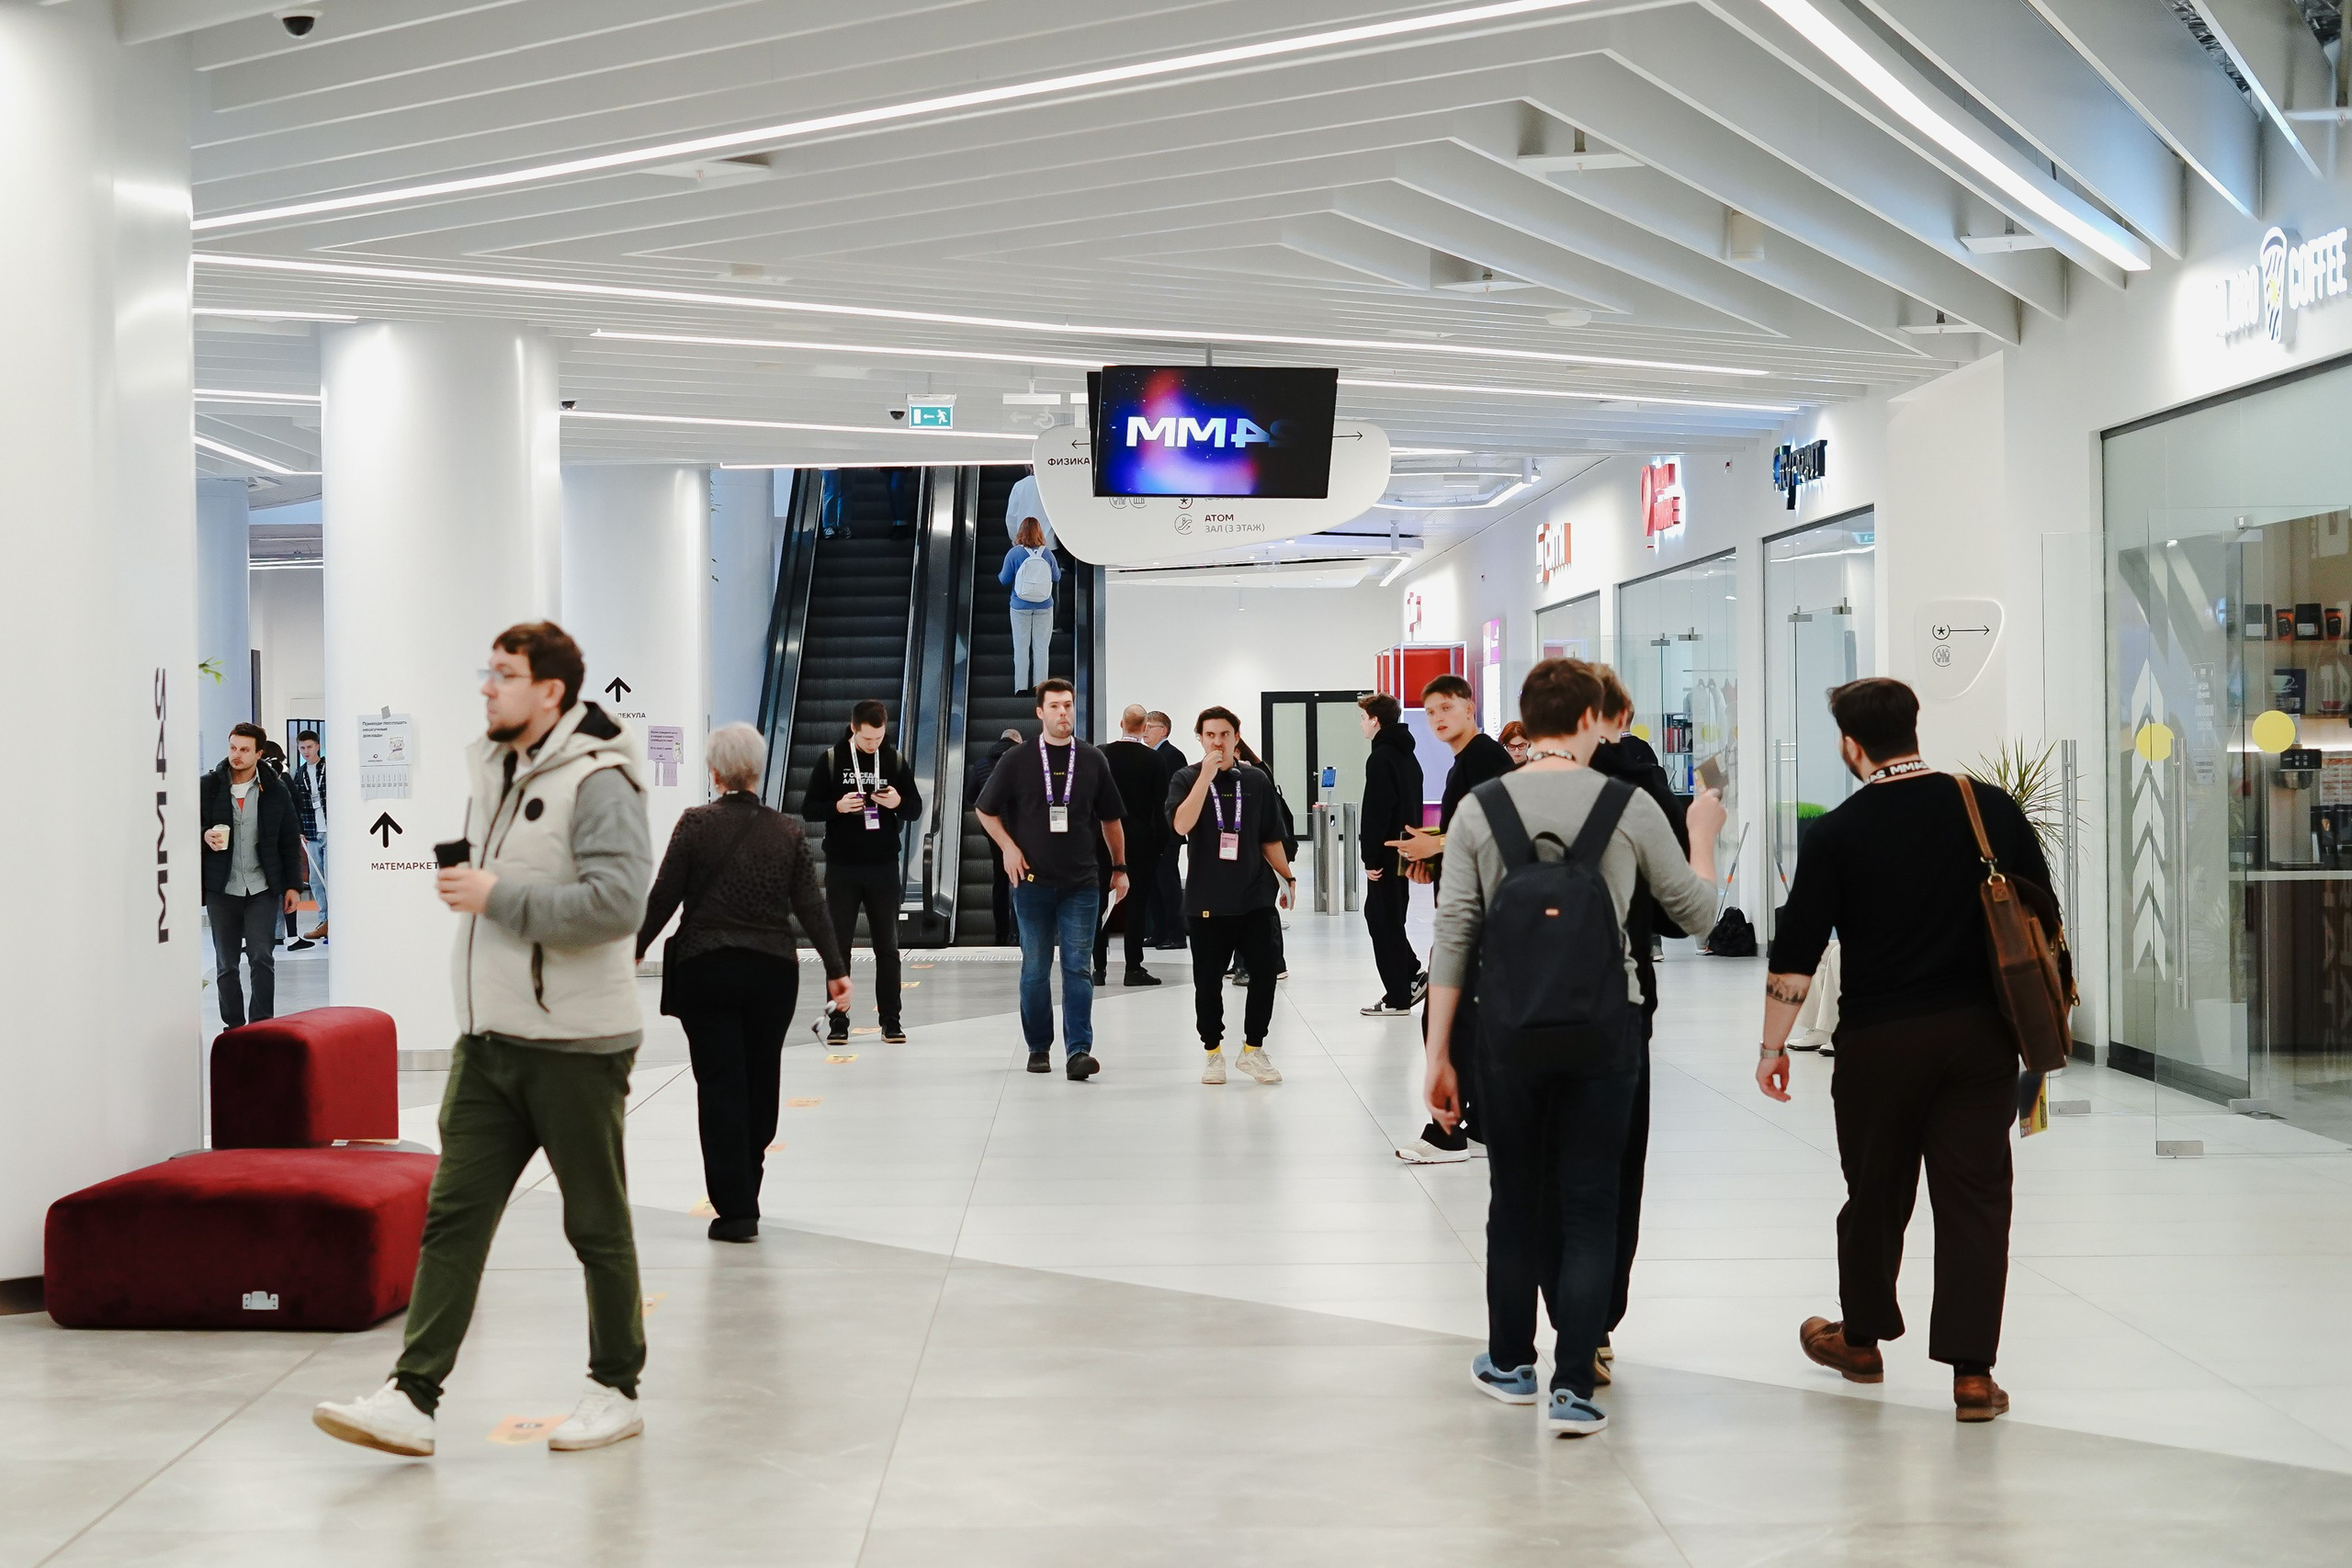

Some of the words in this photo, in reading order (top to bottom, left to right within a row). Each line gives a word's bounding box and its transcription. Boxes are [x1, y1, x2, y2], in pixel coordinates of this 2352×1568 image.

[2288, 227, 2347, 310] COFFEE
[1126, 416, 1285, 447] MMA
[1047, 457, 1091, 466] ФИЗИКА
[1204, 513, 1234, 522] АТОМ
[1204, 525, 1223, 533] ЗАЛ
[1236, 523, 1265, 533] ЭТАЖ)
[370, 862, 439, 871] МАТЕМАРКЕТ
